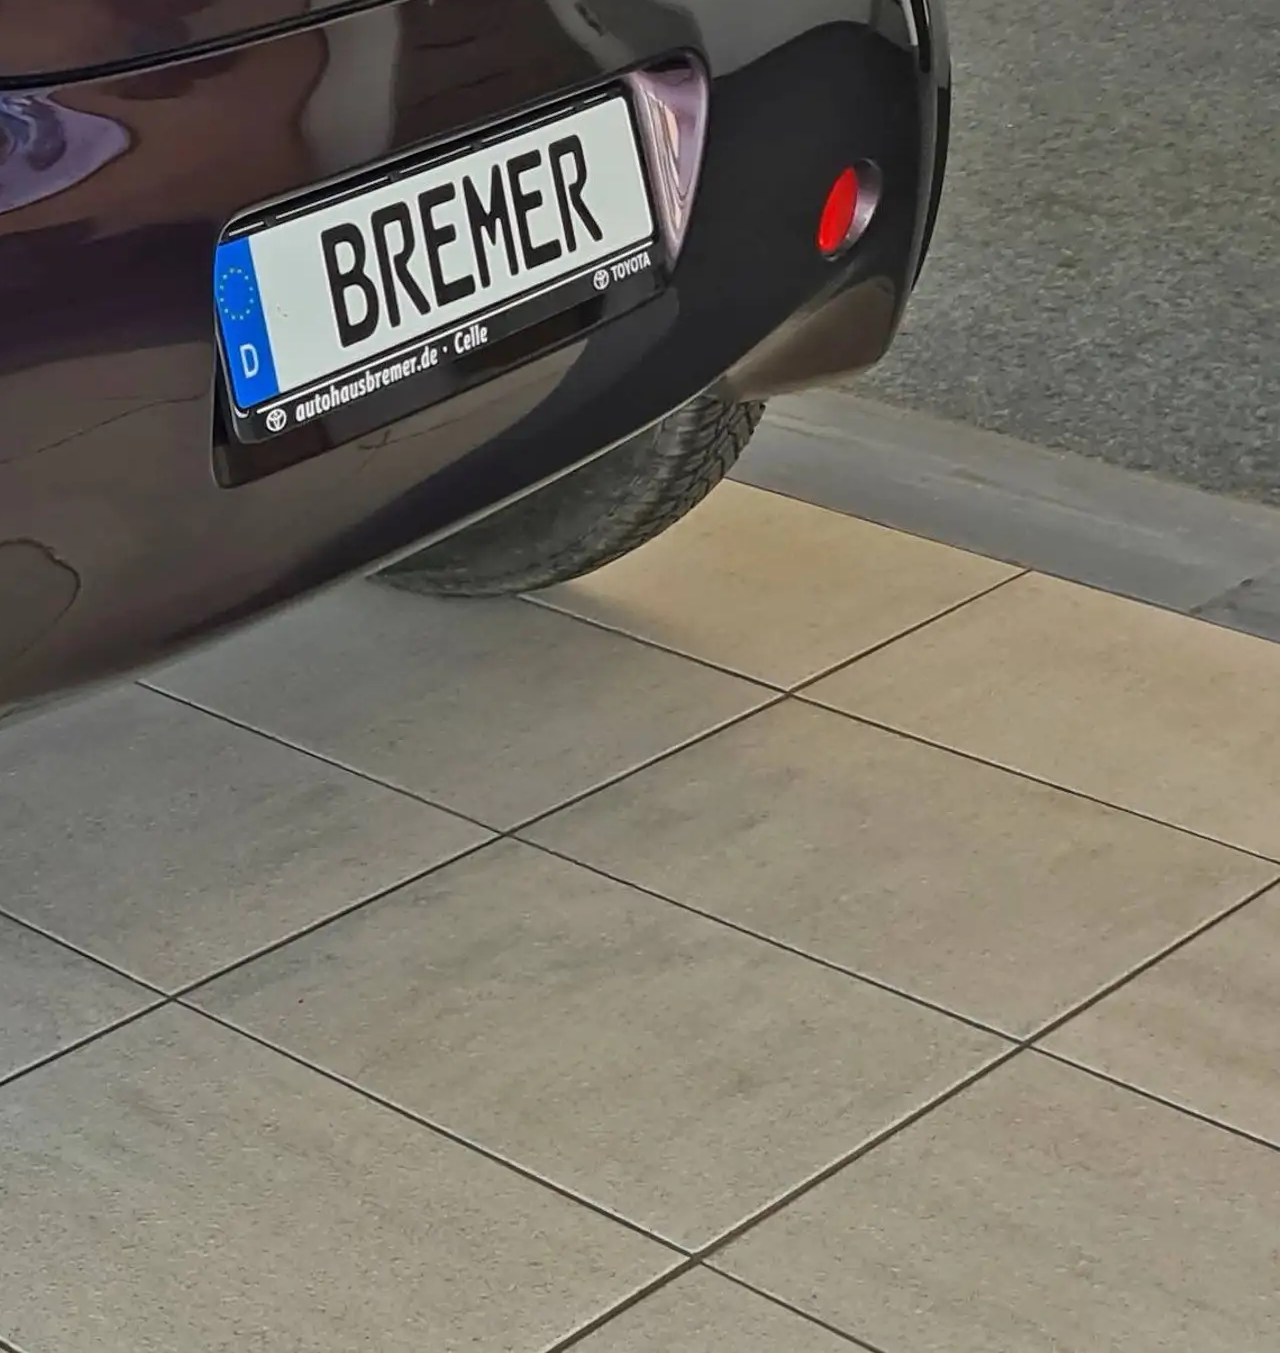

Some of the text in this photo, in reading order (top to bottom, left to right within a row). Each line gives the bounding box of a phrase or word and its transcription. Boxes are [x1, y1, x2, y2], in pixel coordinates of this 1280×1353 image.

[320, 134, 603, 348] BREMER
[610, 251, 652, 282] TOYOTA
[240, 343, 259, 379] D
[295, 325, 489, 422] autohausbremer.de Celle
